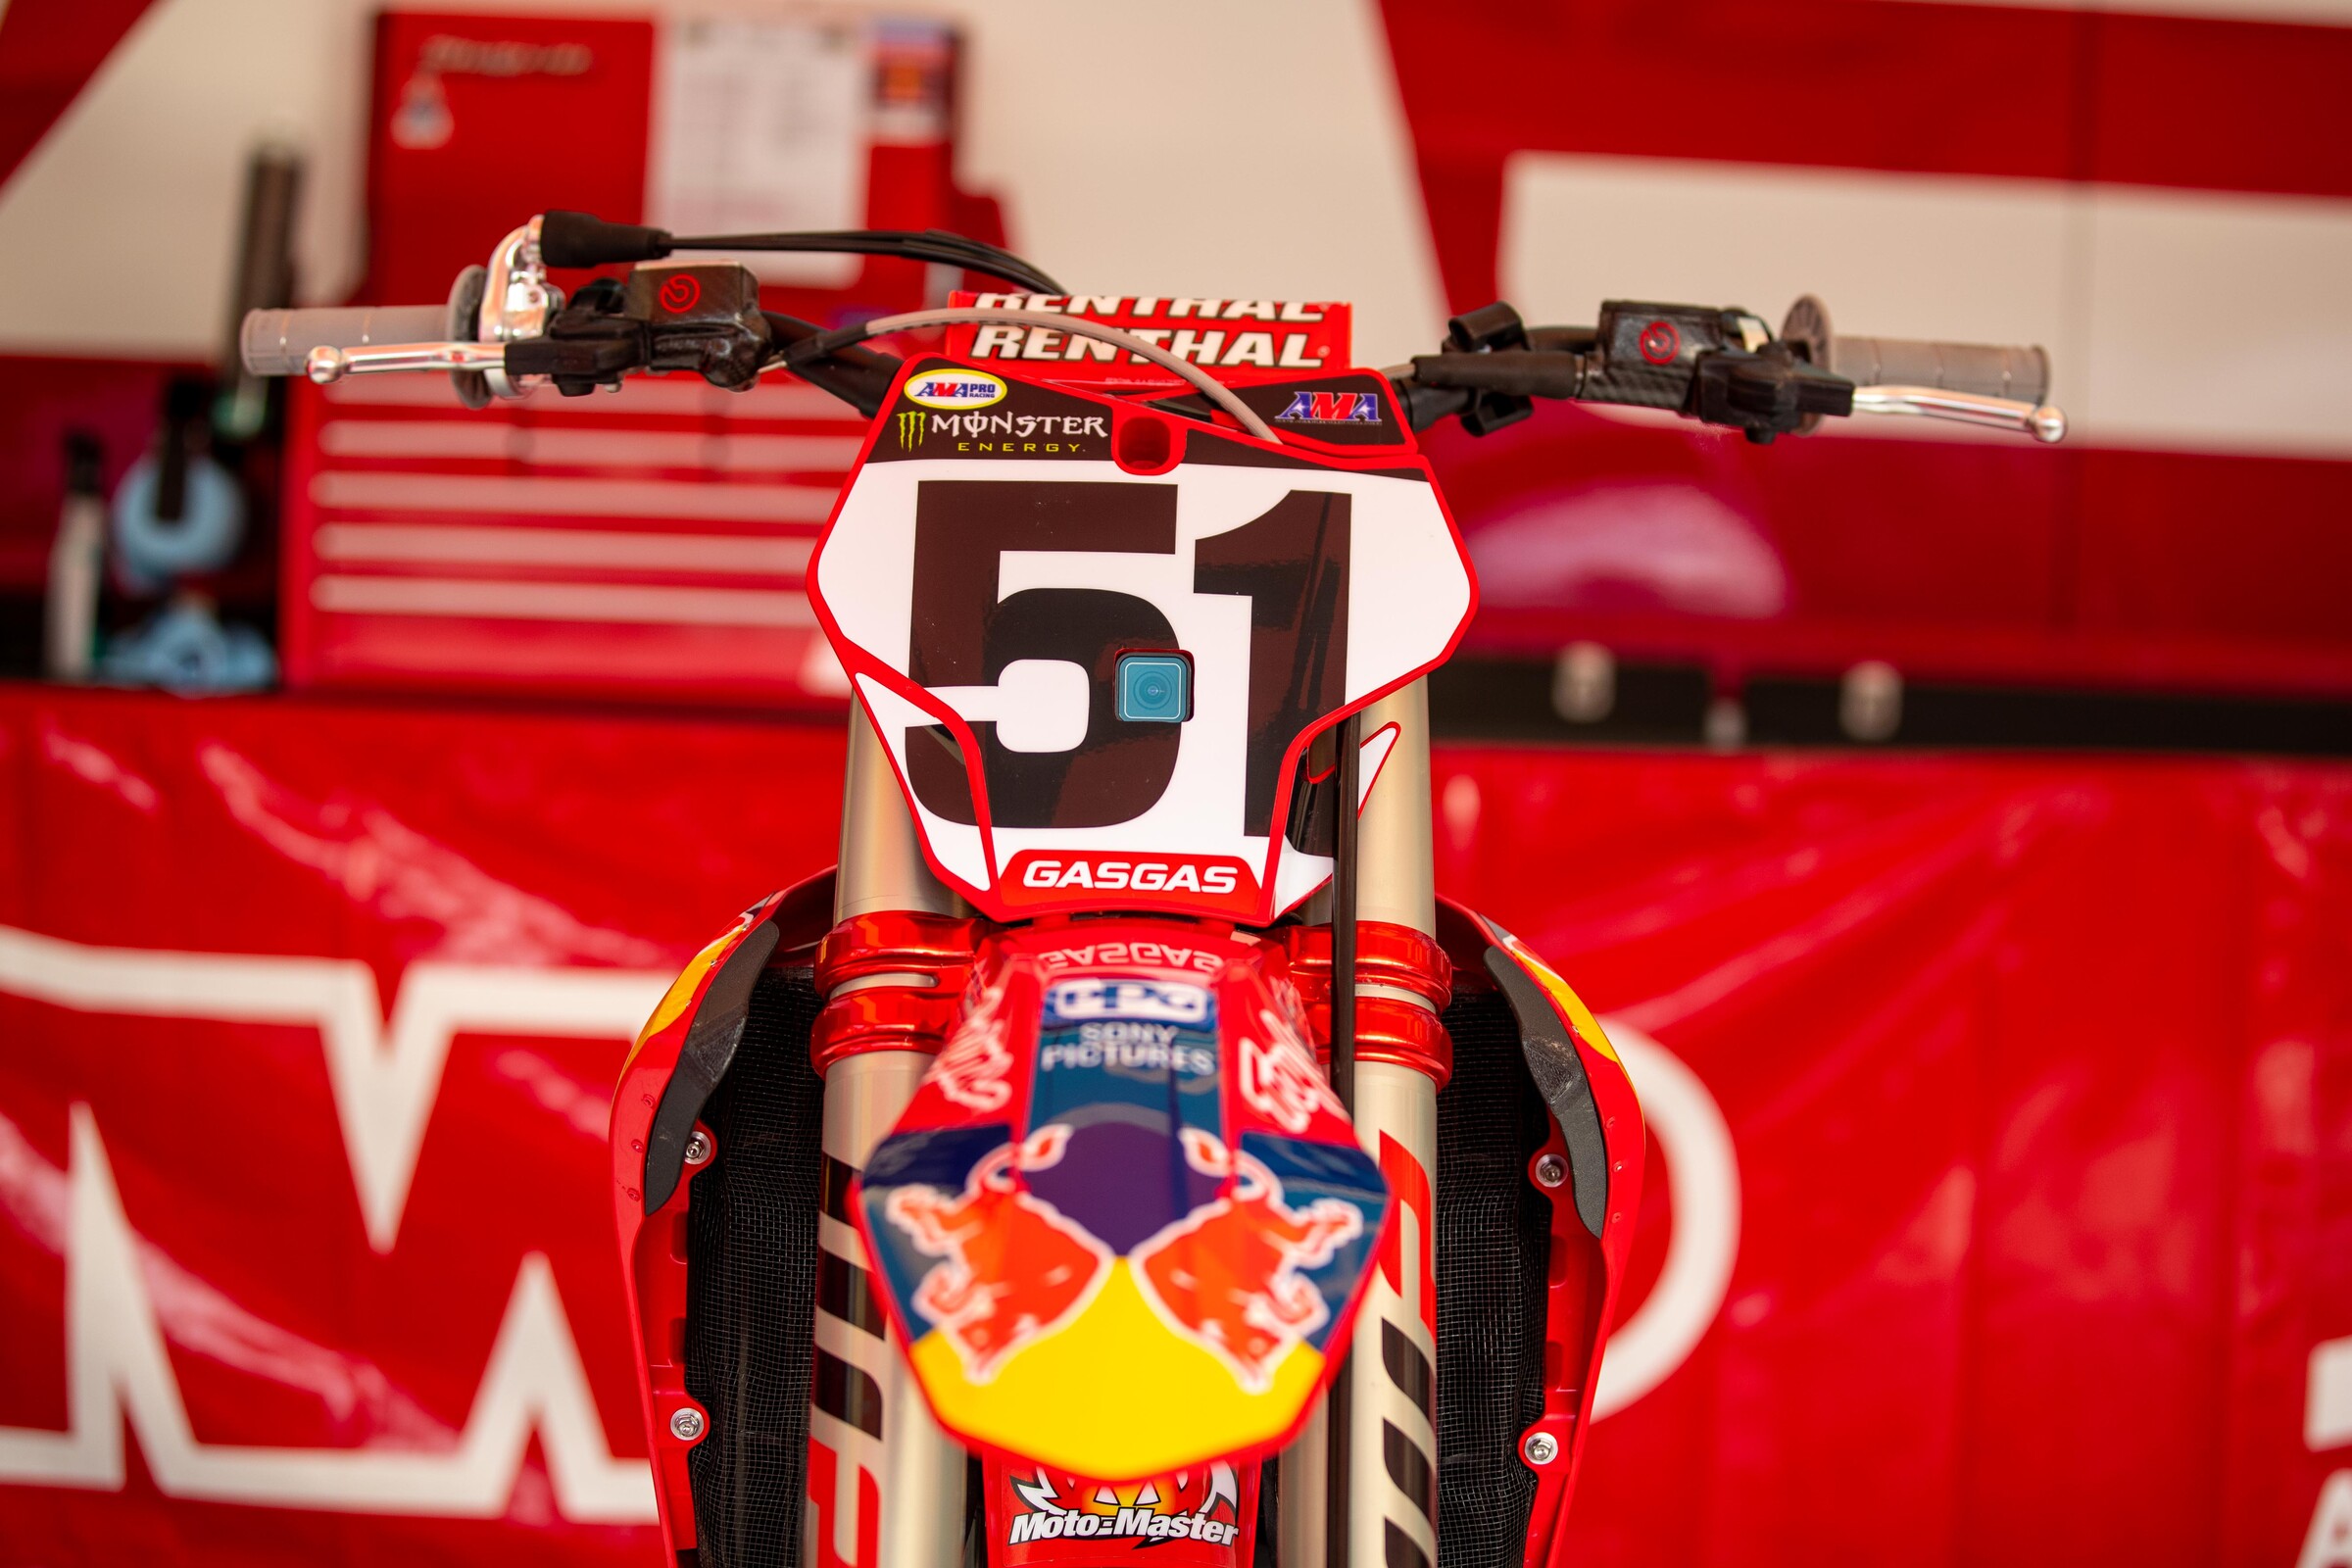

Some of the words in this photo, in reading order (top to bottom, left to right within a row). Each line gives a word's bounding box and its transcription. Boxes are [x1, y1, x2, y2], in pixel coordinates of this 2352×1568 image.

[914, 381, 968, 397] AMA
[970, 383, 996, 393] PRO
[1275, 391, 1382, 421] AMA
[957, 442, 1080, 453] ENERGY
[905, 479, 1351, 857] 51
[1022, 859, 1239, 894] GASGAS
[1079, 1021, 1179, 1043] SONY
[1040, 1041, 1216, 1075] PICTURES
